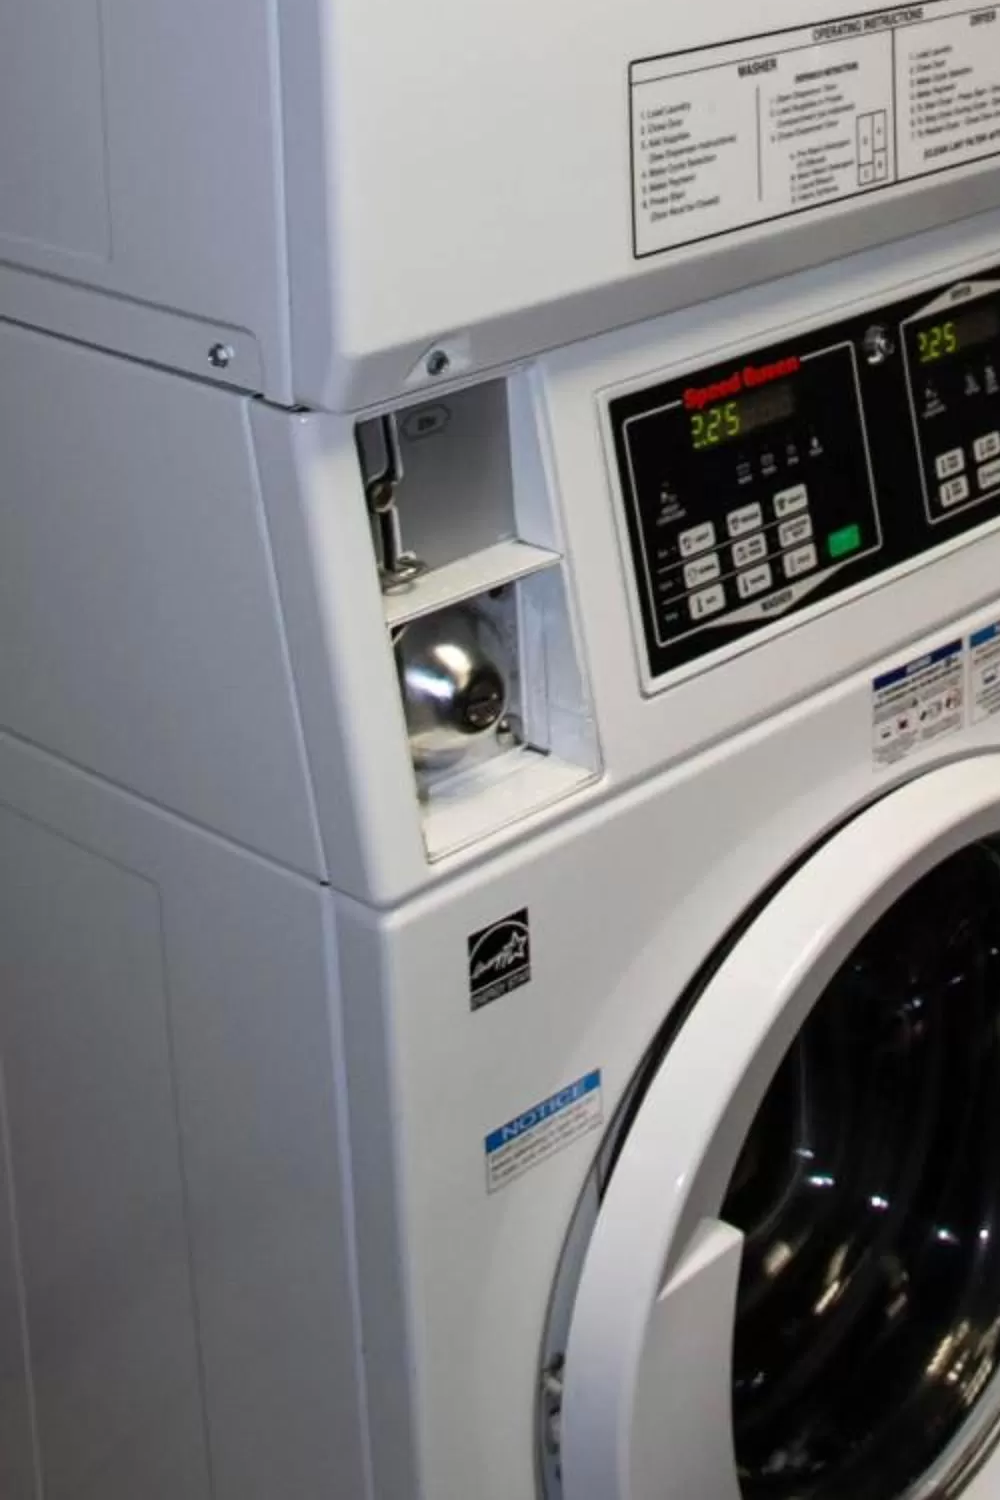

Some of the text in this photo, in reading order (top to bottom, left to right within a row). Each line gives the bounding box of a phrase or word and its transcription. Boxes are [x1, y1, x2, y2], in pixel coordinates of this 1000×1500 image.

[812, 8, 923, 41] OPERATING INSTRUCTIONS
[738, 58, 777, 77] WASHER
[684, 356, 801, 409] Speed Queen
[501, 1082, 584, 1141] NOTICE
